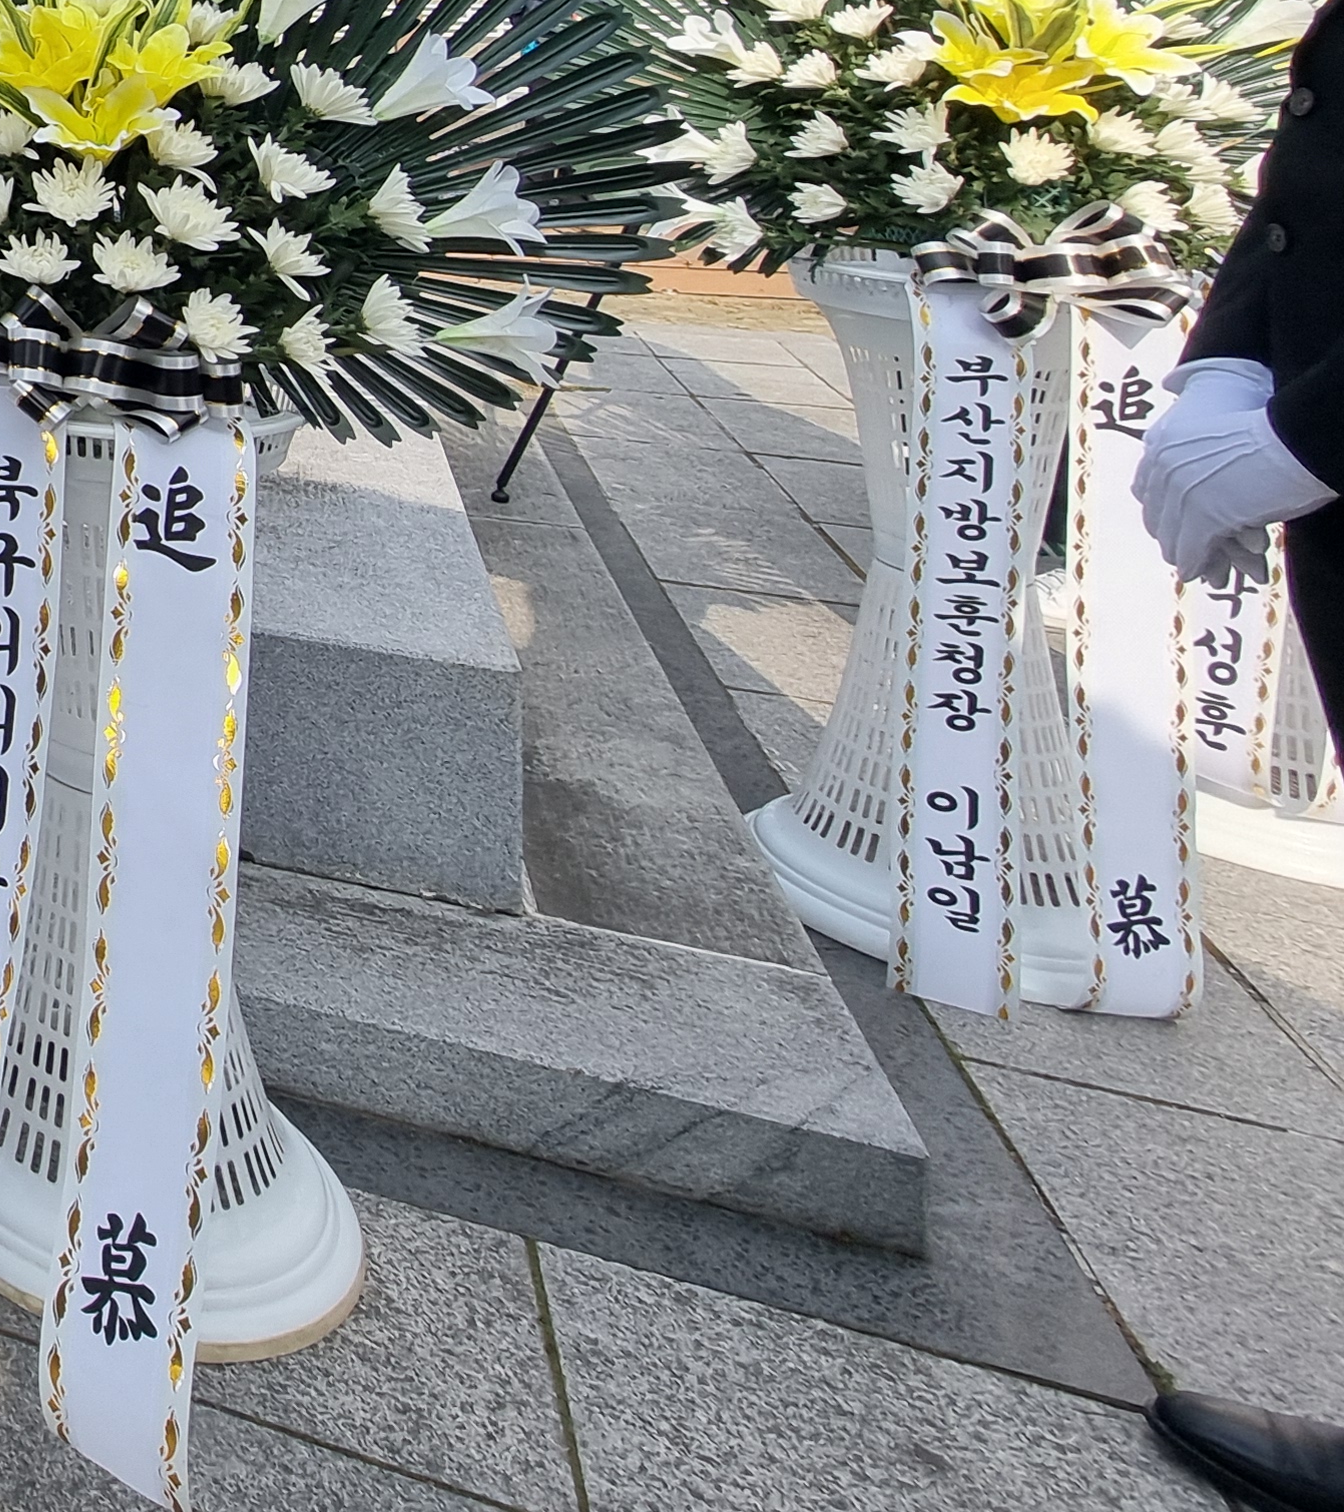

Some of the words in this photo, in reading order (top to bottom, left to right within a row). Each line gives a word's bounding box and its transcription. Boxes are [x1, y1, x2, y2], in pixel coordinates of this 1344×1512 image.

[1090, 365, 1155, 441] 追
[131, 466, 217, 573] 追
[926, 355, 1009, 733] 부산지방보훈청장
[925, 786, 991, 934] 이남일
[1106, 874, 1172, 960] 慕
[81, 1212, 159, 1346] 慕
